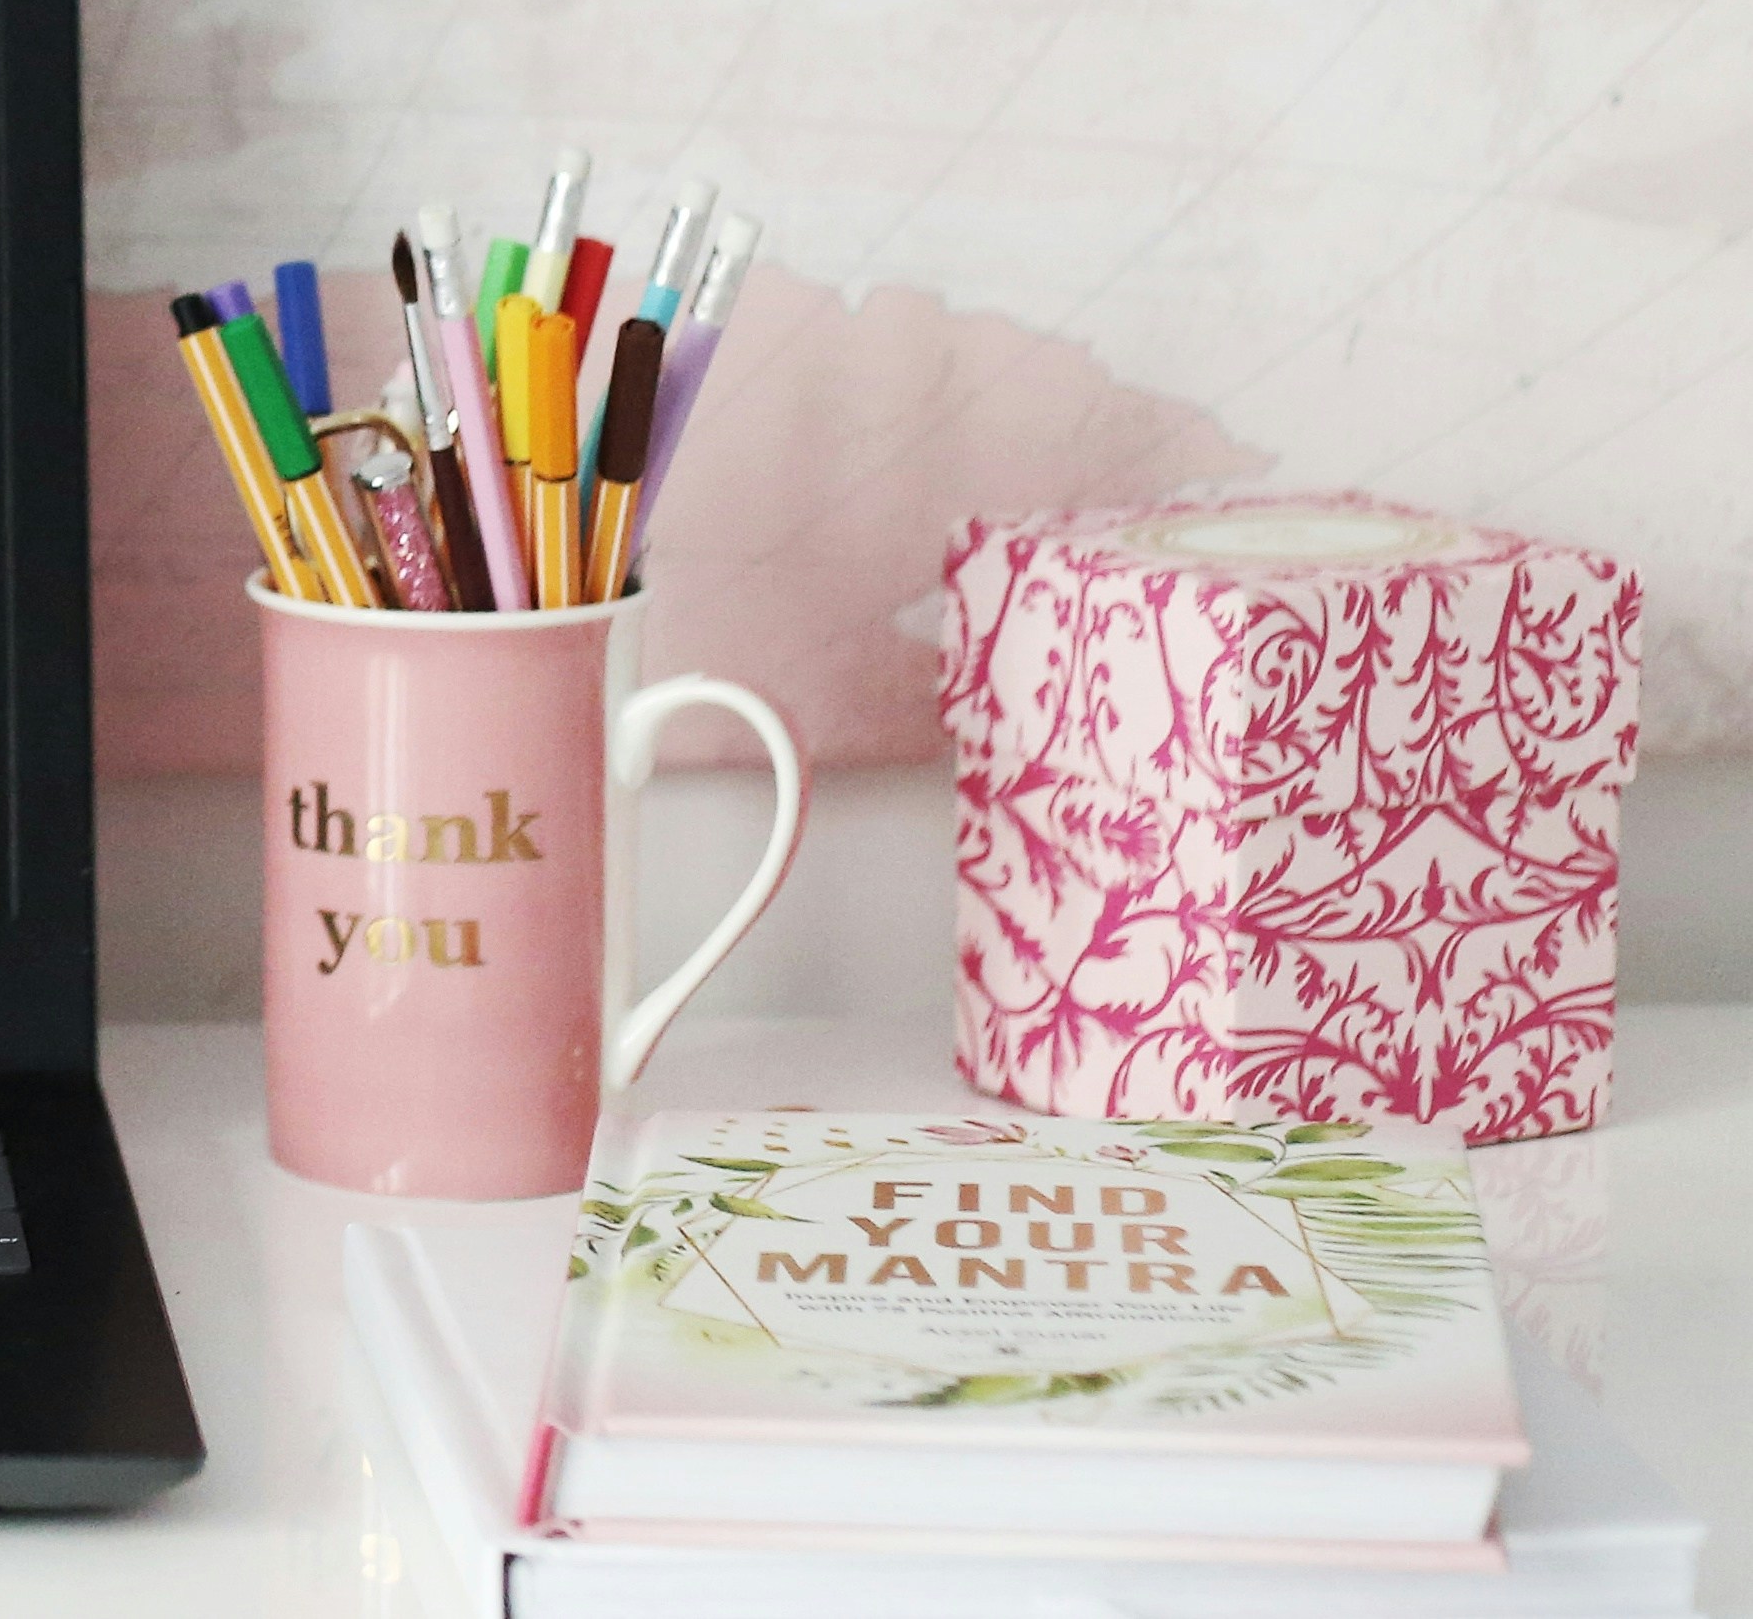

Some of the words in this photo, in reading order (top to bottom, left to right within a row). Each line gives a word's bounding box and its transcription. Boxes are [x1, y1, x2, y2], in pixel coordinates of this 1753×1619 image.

[287, 780, 545, 864] thank
[315, 907, 485, 976] you
[872, 1181, 1167, 1217] FIND
[848, 1216, 1192, 1256] YOUR
[757, 1251, 1290, 1298] MANTRA
[962, 1297, 1100, 1309] Empower
